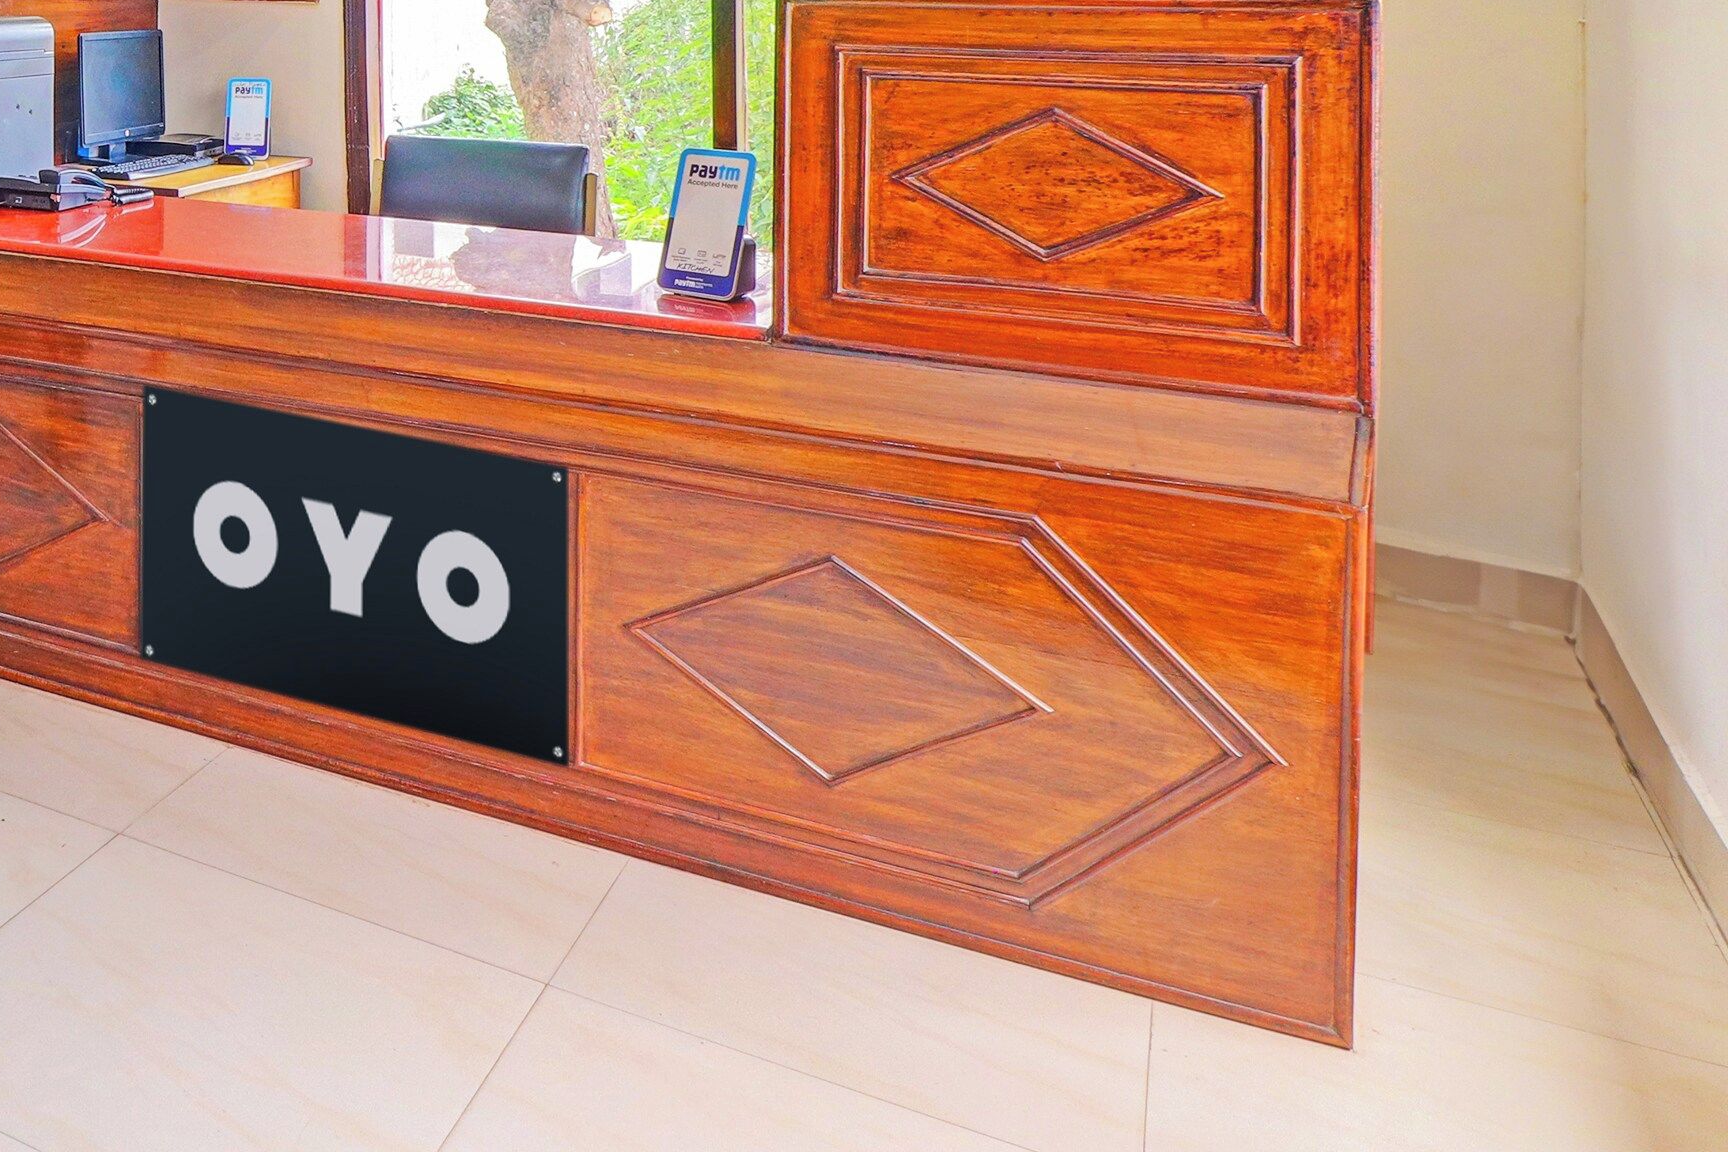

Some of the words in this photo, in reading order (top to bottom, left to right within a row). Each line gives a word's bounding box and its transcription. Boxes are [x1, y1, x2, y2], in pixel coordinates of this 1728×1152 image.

[687, 179, 720, 188] Accepted
[676, 263, 715, 274] KITCHEN
[193, 480, 510, 645] OYO
